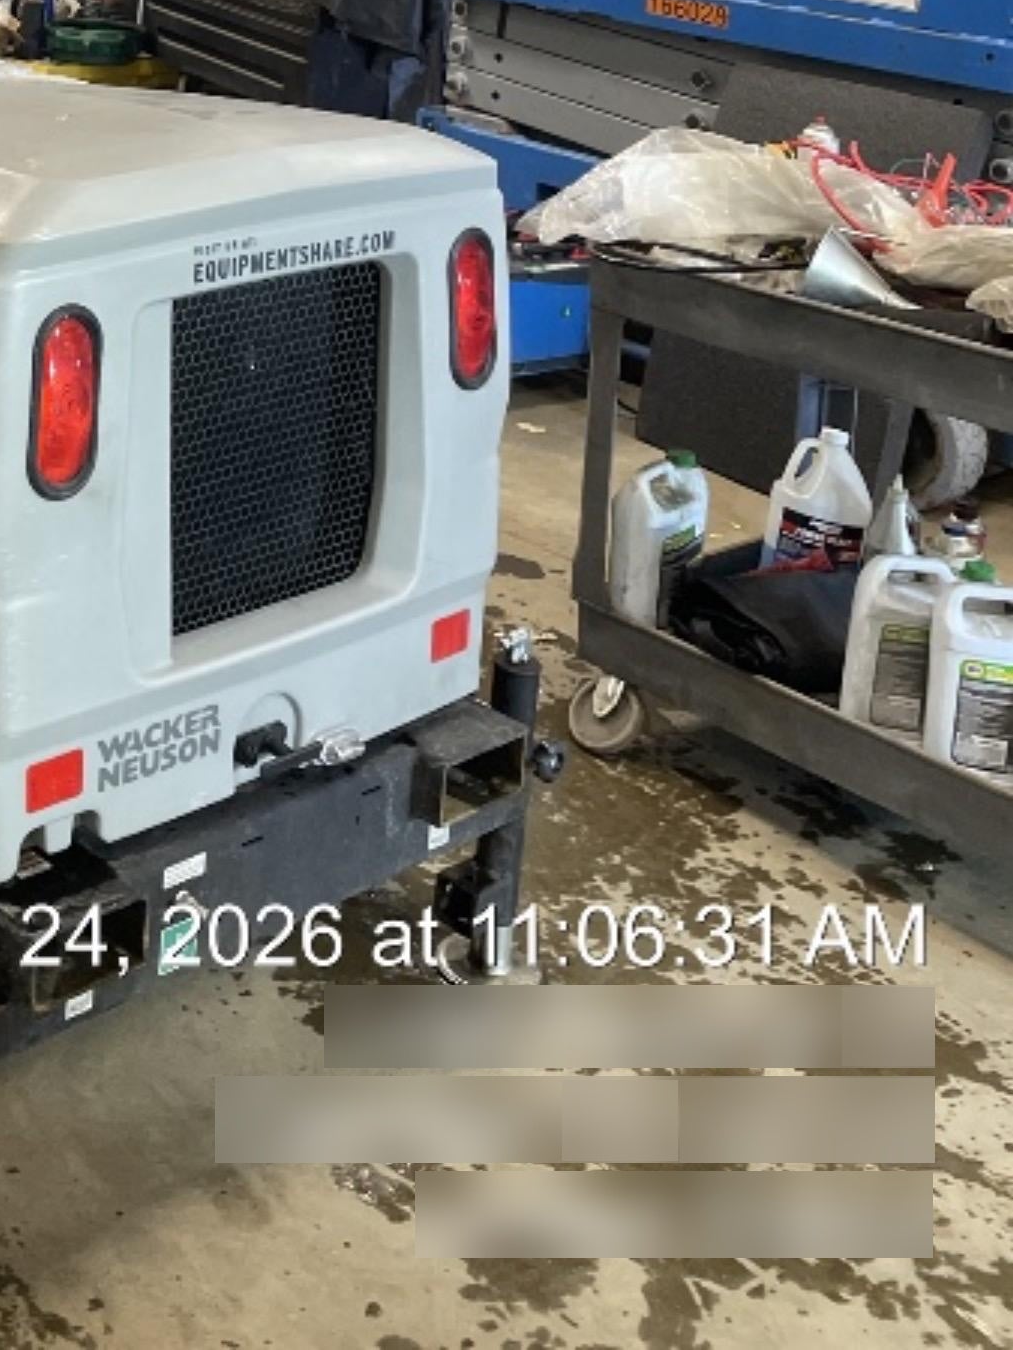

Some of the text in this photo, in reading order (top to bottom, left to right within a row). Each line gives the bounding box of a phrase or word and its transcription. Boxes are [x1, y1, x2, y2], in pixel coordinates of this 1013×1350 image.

[193, 230, 395, 285] EQUIPMENTSHARE.COM
[97, 704, 221, 764] WACKER
[97, 728, 222, 793] NEUSON
